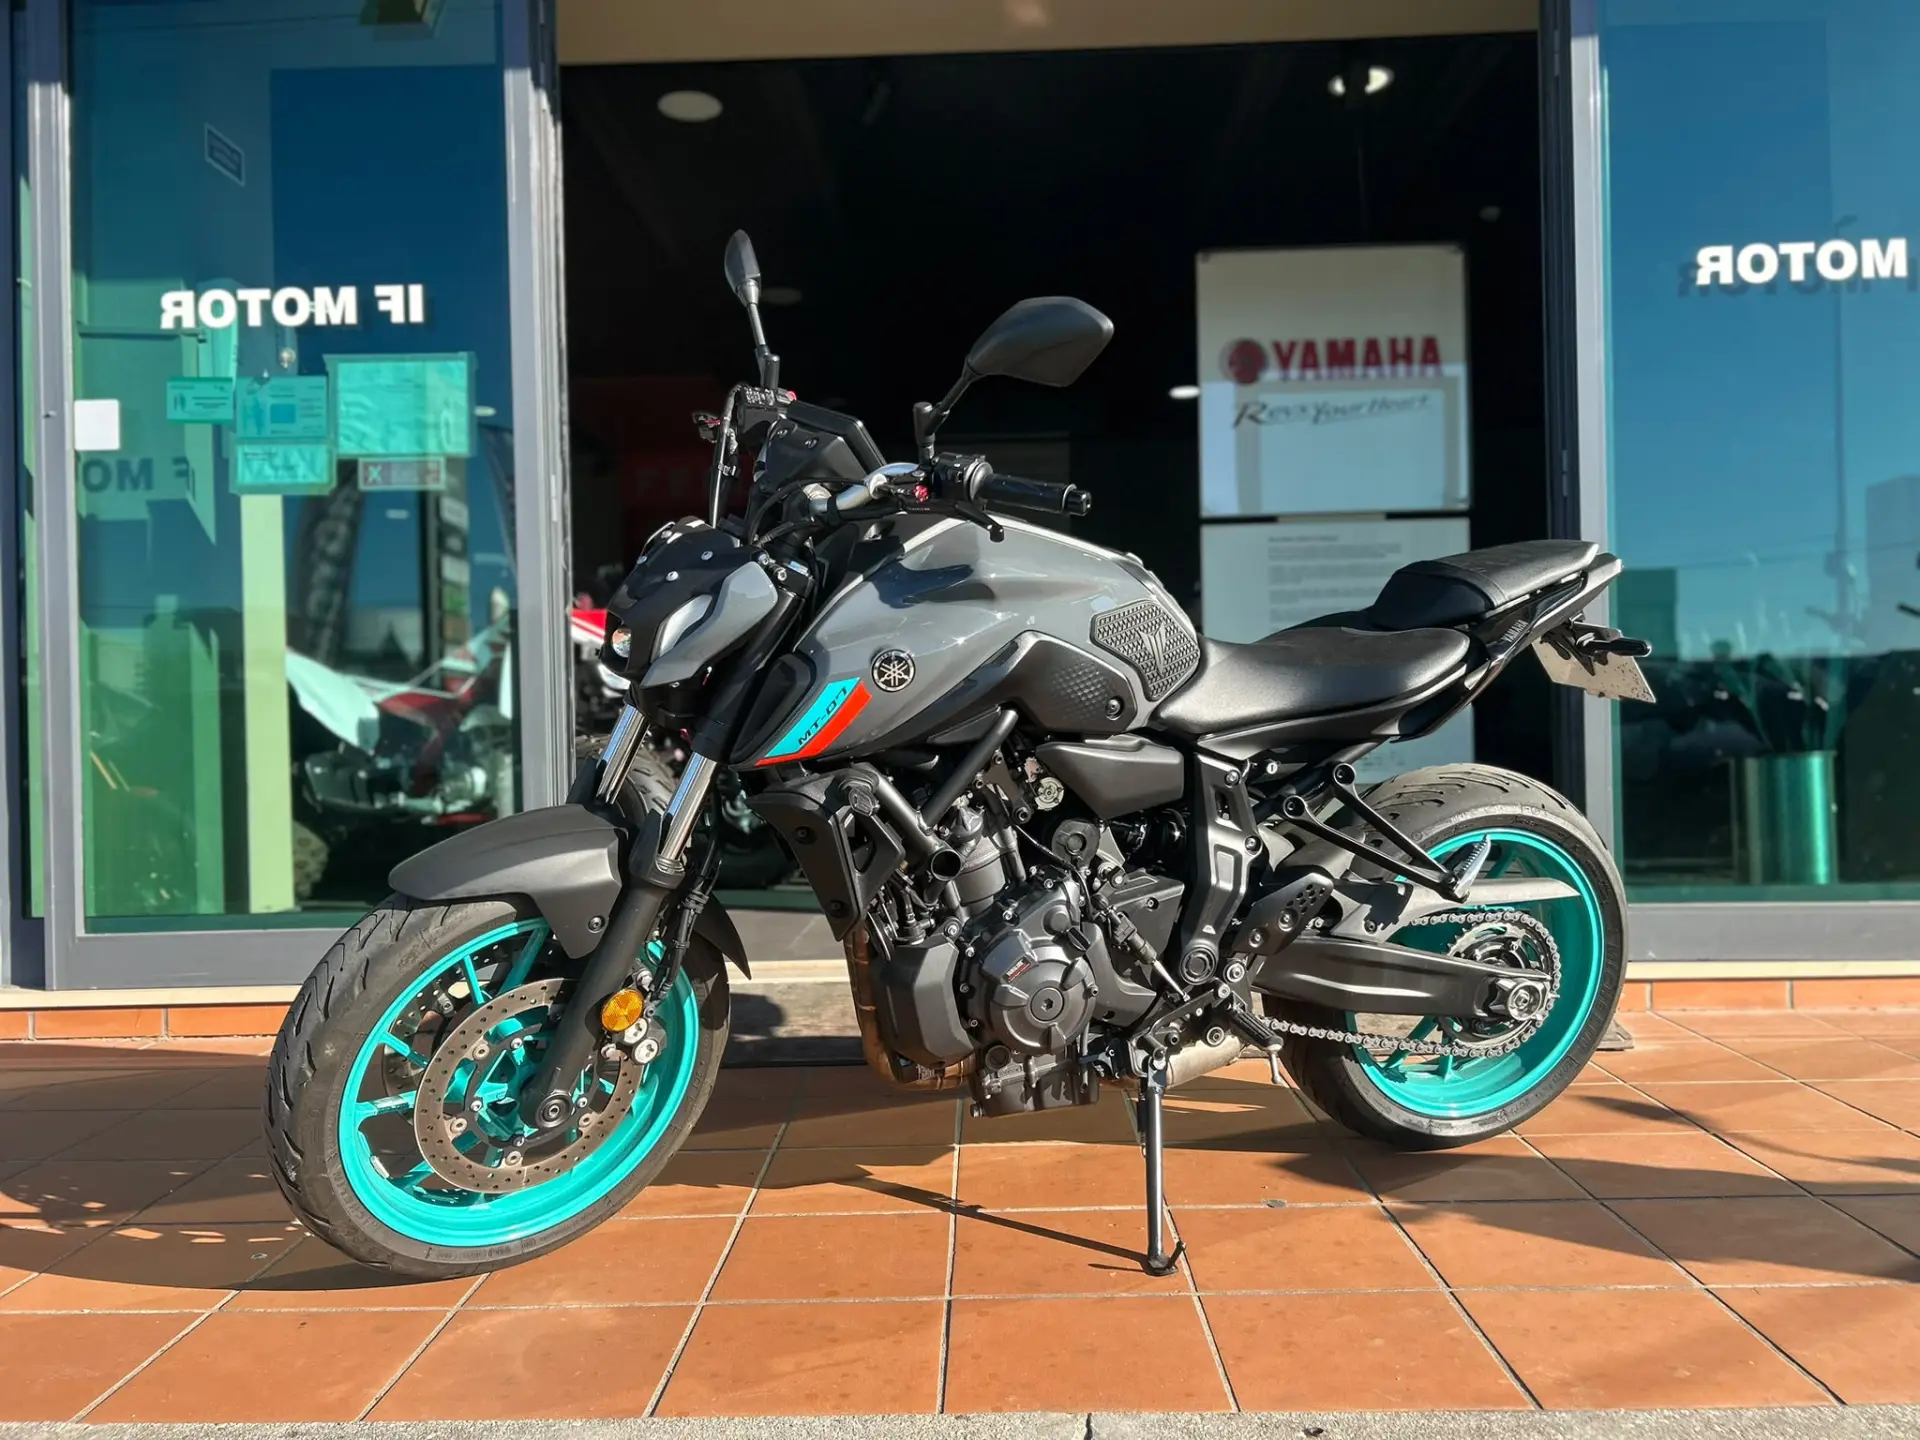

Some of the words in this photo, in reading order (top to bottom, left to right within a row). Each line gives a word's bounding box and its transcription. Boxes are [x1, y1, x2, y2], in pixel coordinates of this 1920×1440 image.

[1272, 335, 1444, 381] YAMAHA
[1500, 619, 1528, 643] YAMAHA
[797, 686, 847, 745] MT-07
